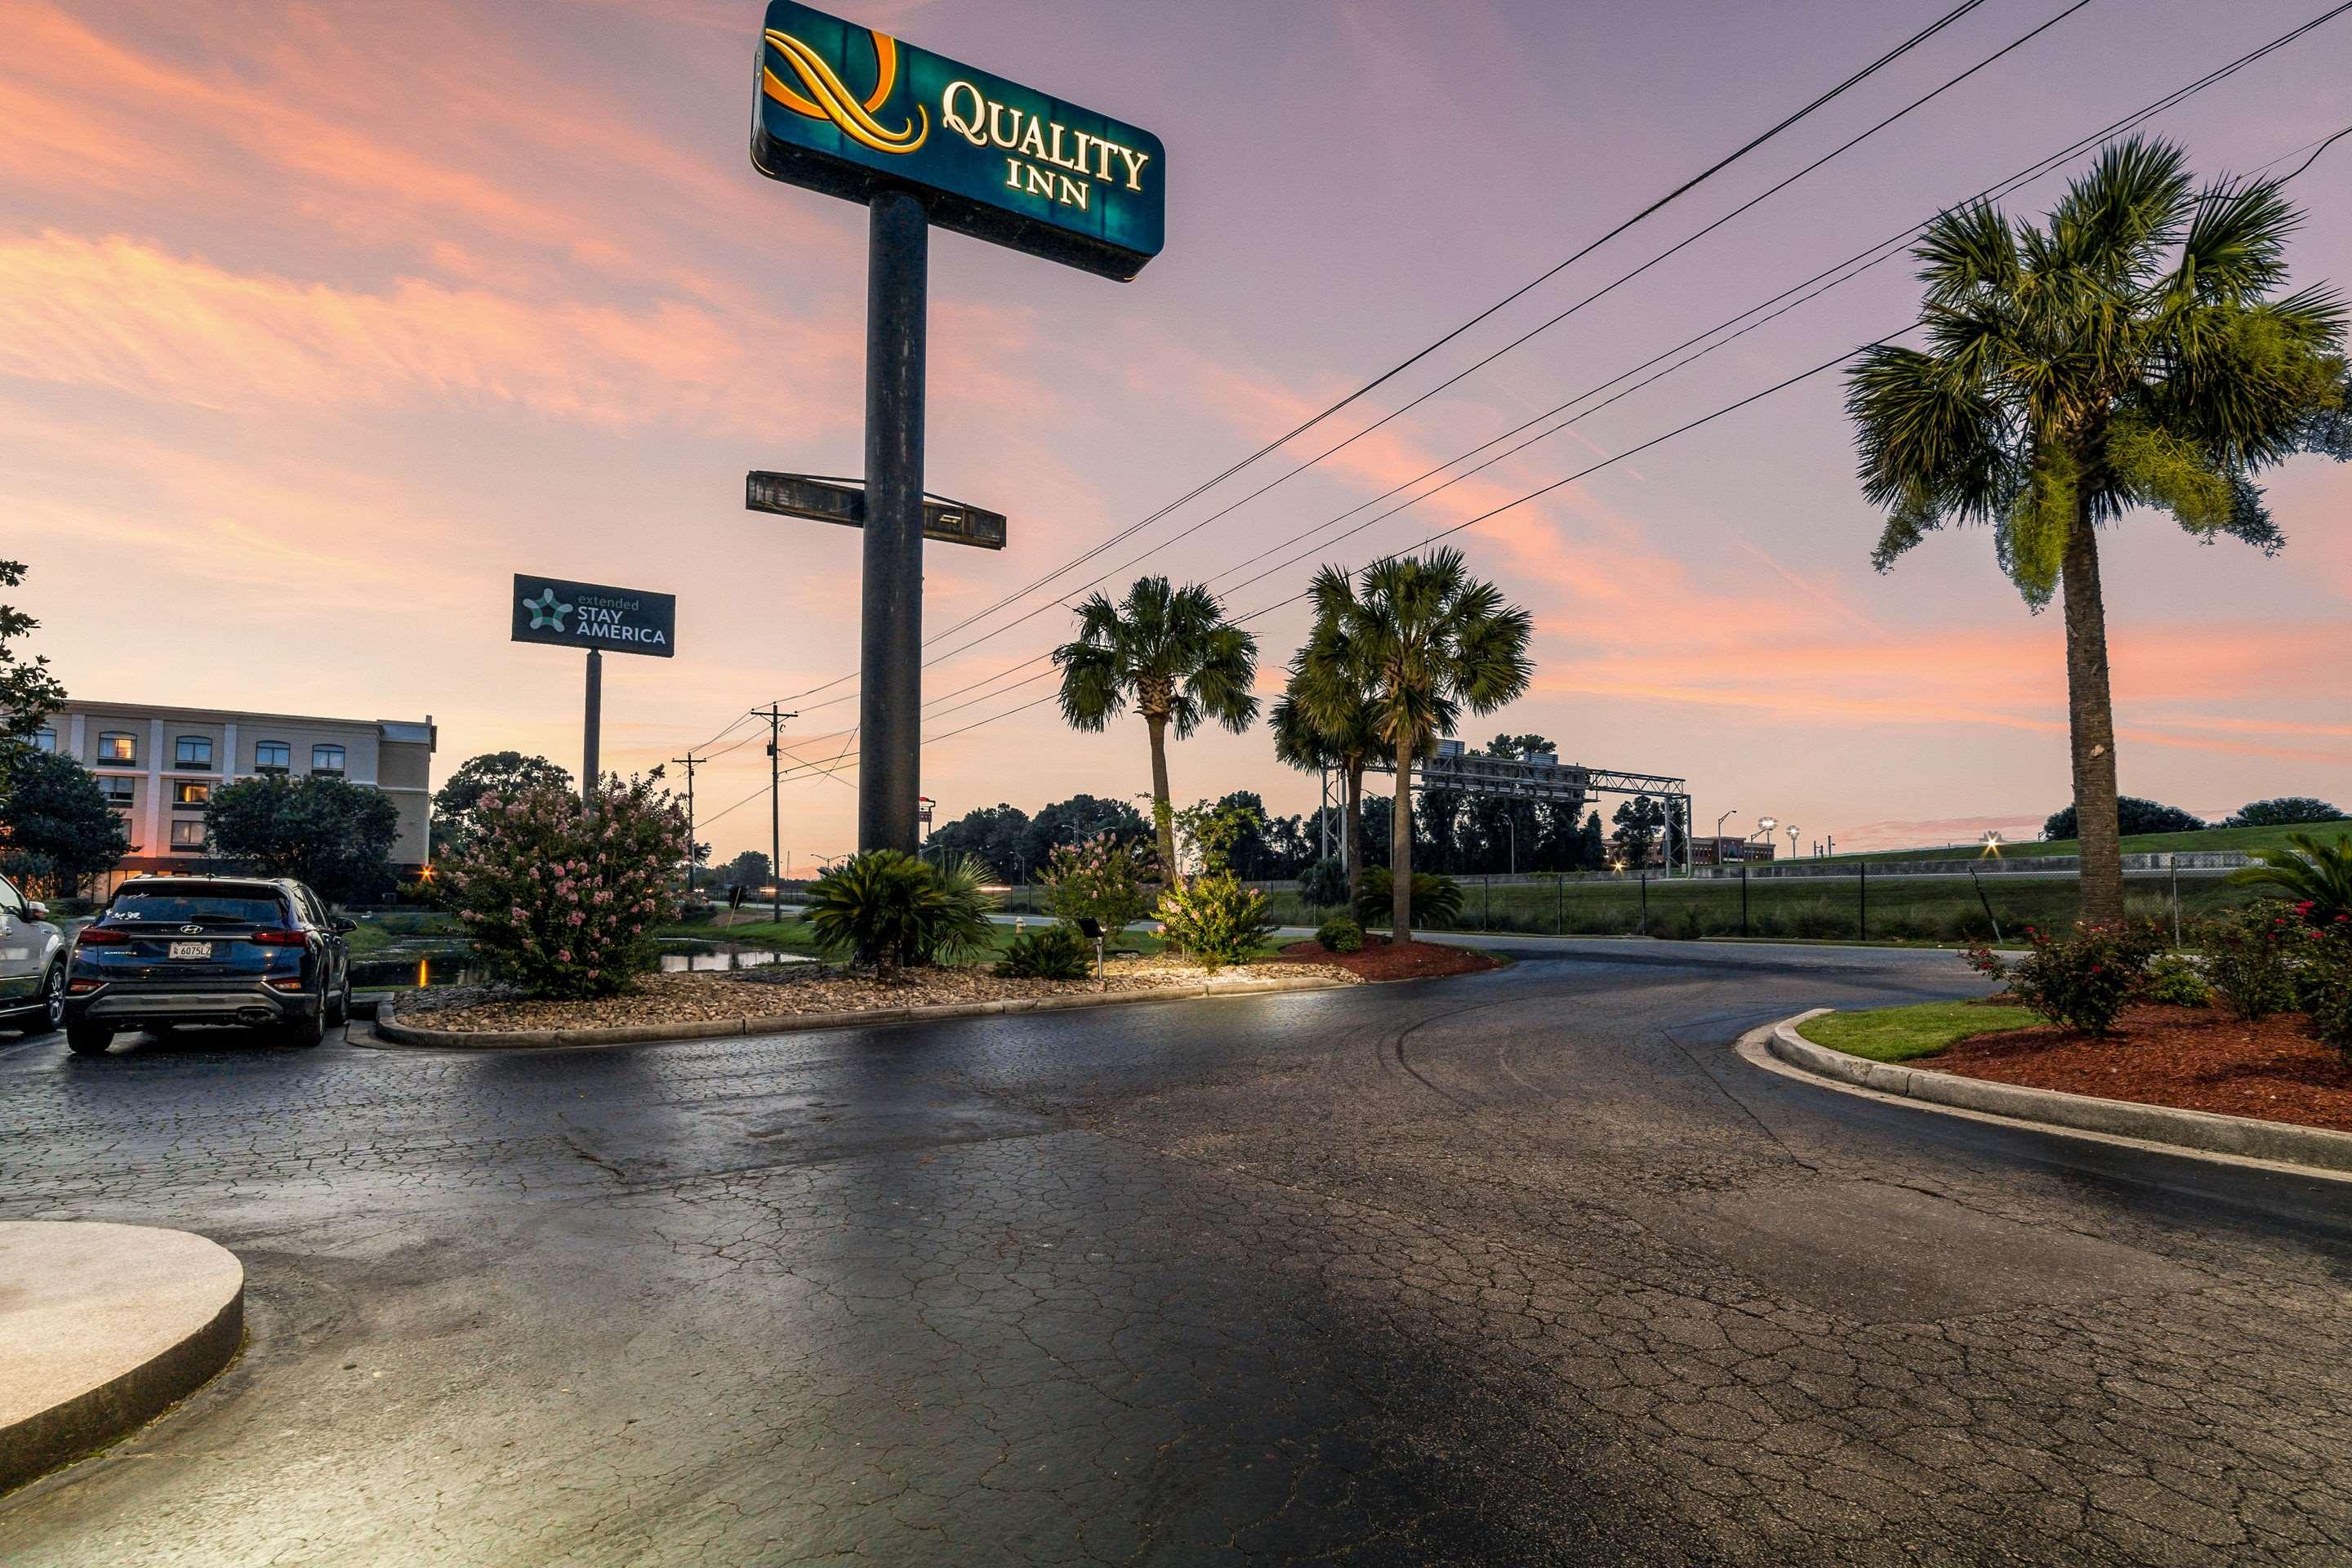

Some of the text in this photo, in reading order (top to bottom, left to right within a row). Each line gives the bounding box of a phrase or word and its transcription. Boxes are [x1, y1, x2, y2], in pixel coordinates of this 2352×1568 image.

[941, 80, 1150, 193] QUALITY
[1006, 157, 1089, 211] INN
[577, 594, 640, 612] extended
[577, 606, 624, 624] STAY
[576, 621, 666, 644] AMERICA
